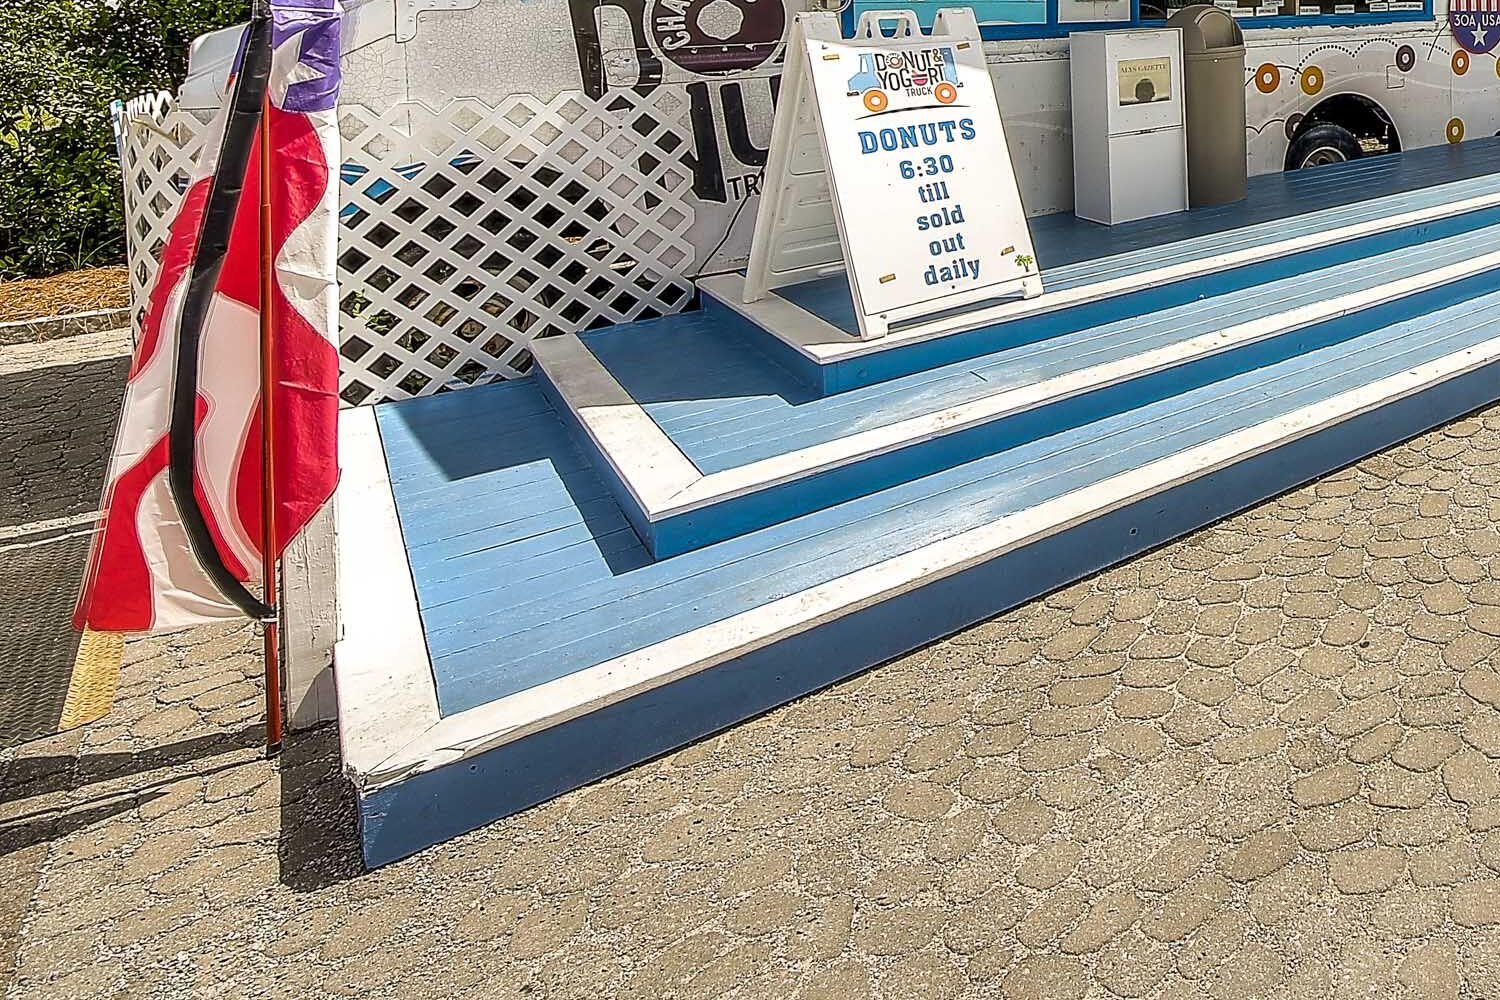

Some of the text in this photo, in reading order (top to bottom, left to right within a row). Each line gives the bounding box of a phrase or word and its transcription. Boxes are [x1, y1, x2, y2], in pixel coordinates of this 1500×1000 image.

[906, 87, 933, 97] TRUCK
[858, 118, 977, 155] DONUTS
[899, 154, 955, 179] 6:30
[918, 181, 950, 203] till
[916, 204, 966, 231] sold
[929, 232, 966, 257] out
[924, 259, 981, 286] daily
